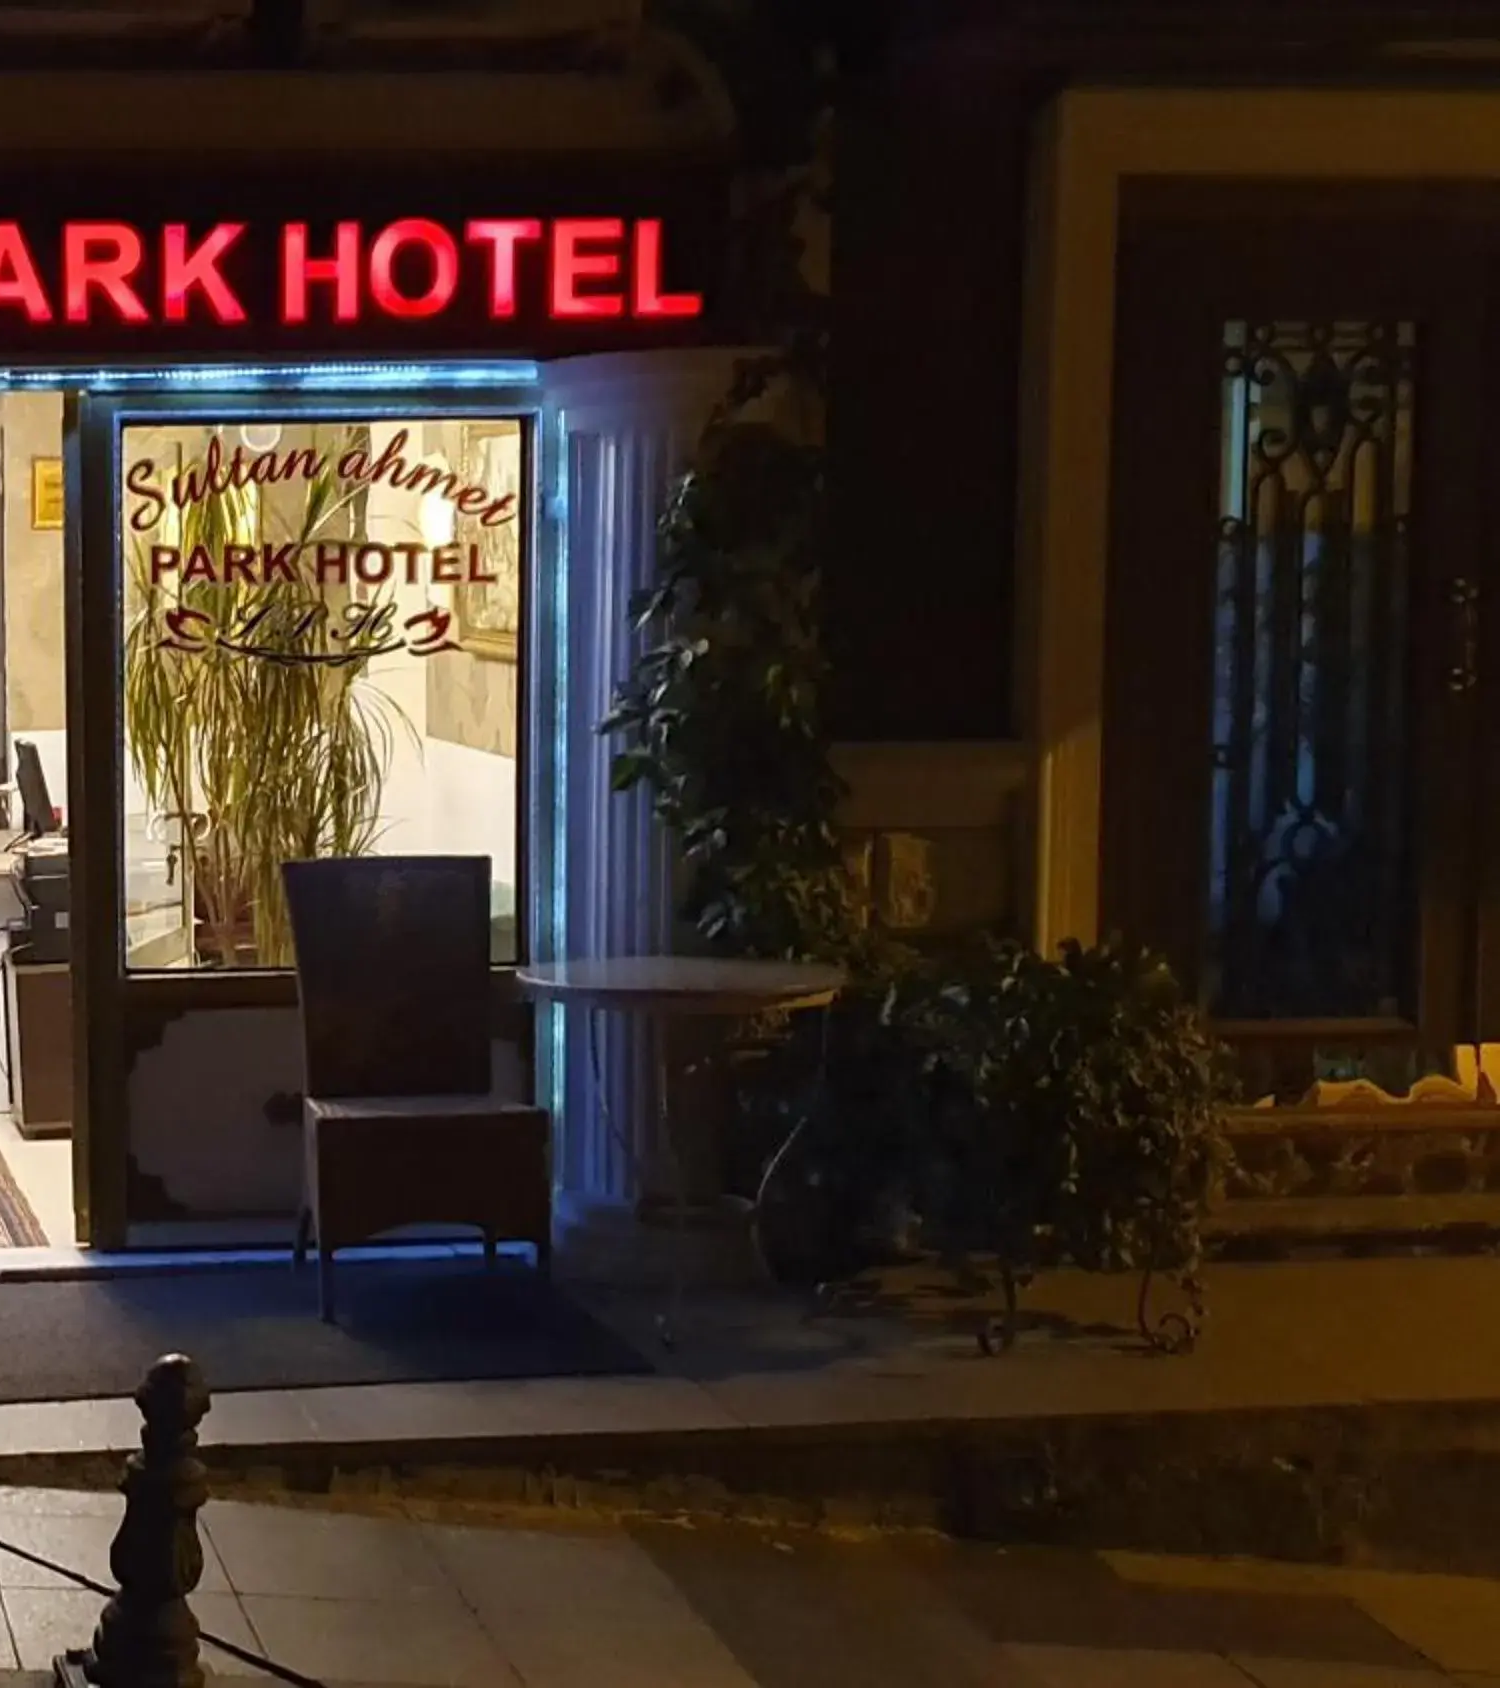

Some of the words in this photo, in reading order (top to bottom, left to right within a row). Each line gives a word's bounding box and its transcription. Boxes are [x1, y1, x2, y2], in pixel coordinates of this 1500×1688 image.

[280, 217, 702, 322] HOTEL
[125, 435, 326, 532] Sultan
[337, 428, 516, 527] ahmet
[150, 543, 300, 586] PARK
[315, 541, 497, 585] HOTEL
